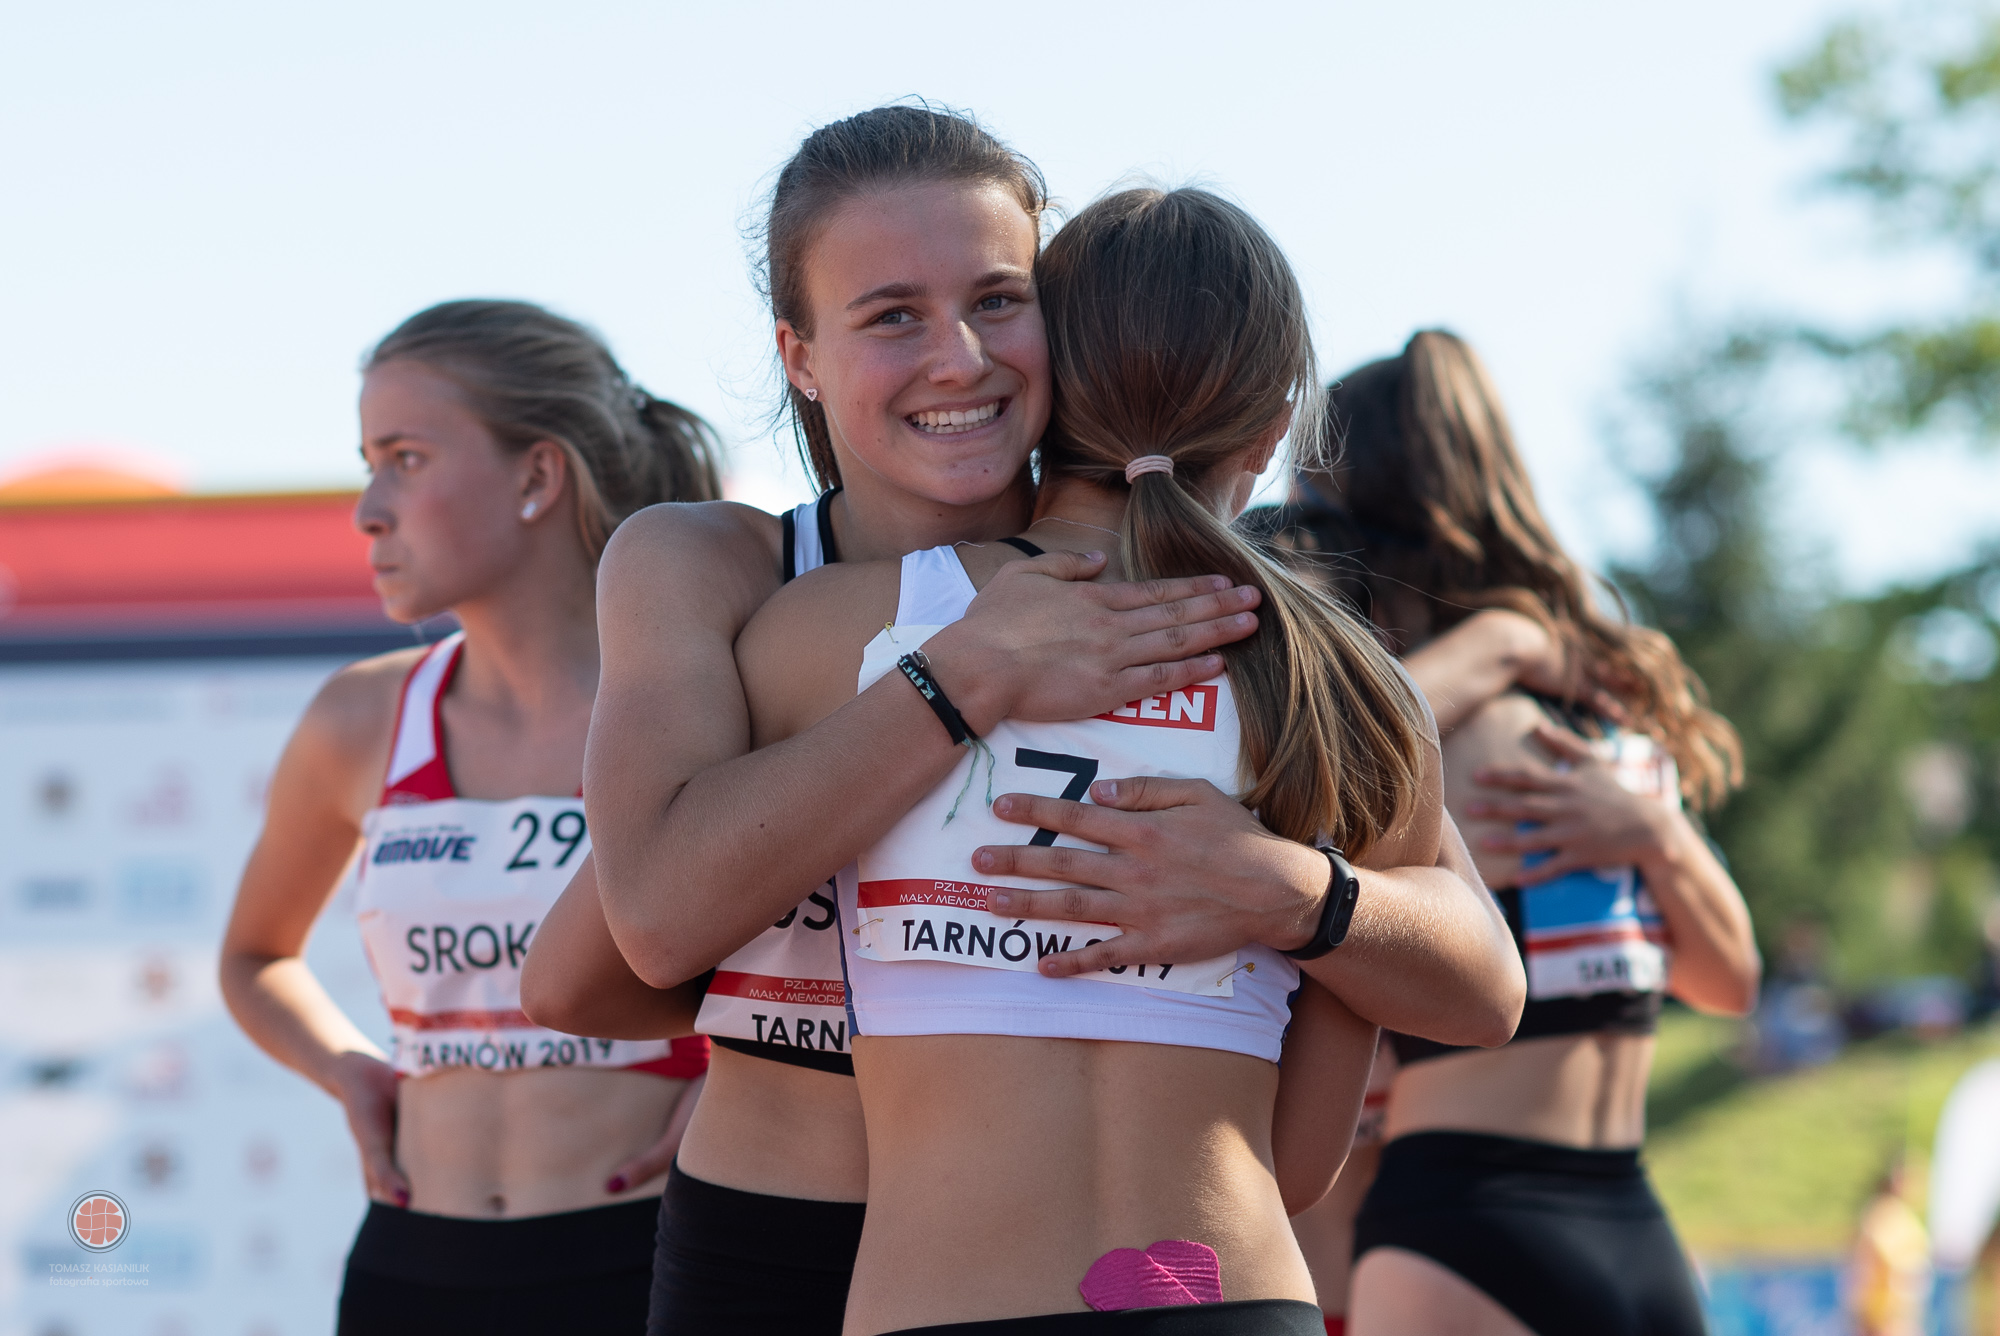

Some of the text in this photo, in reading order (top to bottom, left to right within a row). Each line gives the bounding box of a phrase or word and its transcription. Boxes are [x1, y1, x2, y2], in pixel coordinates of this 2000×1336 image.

[1104, 690, 1206, 724] LEN
[1014, 747, 1099, 847] 7
[934, 881, 970, 894] PZLA
[899, 893, 933, 903] MAŁY
[784, 979, 819, 991] PZLA
[749, 988, 783, 1000] MAŁY
